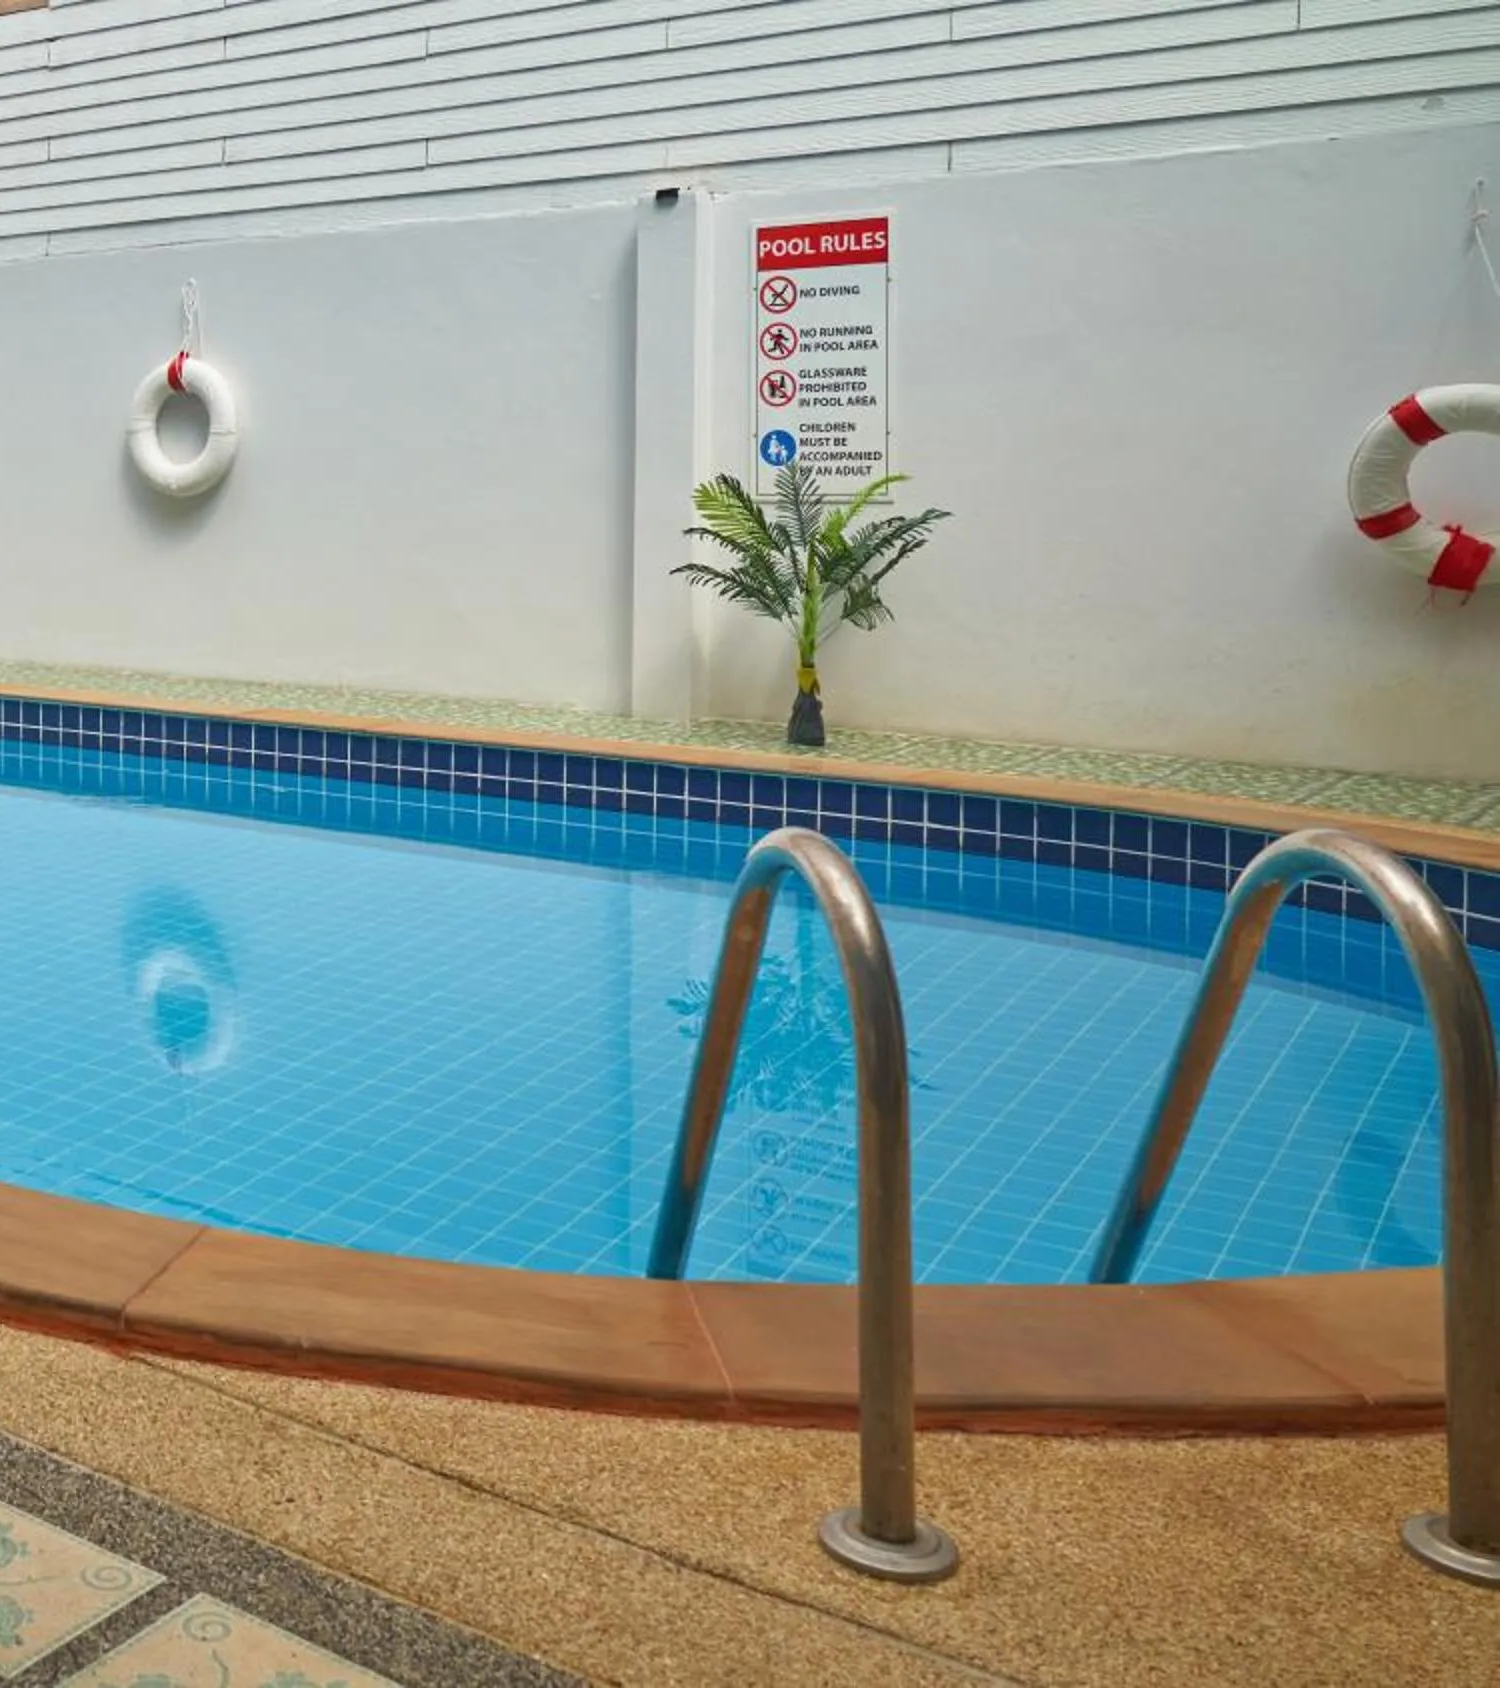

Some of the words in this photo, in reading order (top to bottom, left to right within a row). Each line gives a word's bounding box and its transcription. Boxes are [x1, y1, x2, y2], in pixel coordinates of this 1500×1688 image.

[759, 237, 816, 258] POOL
[820, 231, 886, 253] RULES
[800, 288, 816, 298] NO
[820, 285, 860, 297] DIVING
[800, 327, 816, 338] NO
[820, 325, 873, 336] RUNNING
[800, 342, 811, 352] IN
[814, 341, 844, 351] POOL
[848, 339, 879, 350] AREA
[799, 367, 867, 378] GLASSWARE
[799, 382, 867, 392] PROHIBITED
[799, 398, 811, 407] IN
[813, 397, 844, 407] POOL
[846, 396, 877, 406] AREA
[799, 422, 856, 432] CHILDREN
[799, 438, 830, 447] MUST
[833, 437, 848, 446] BE
[799, 451, 882, 461] ACCOMPANIED
[816, 466, 832, 476] AN
[835, 465, 873, 476] ADULT
